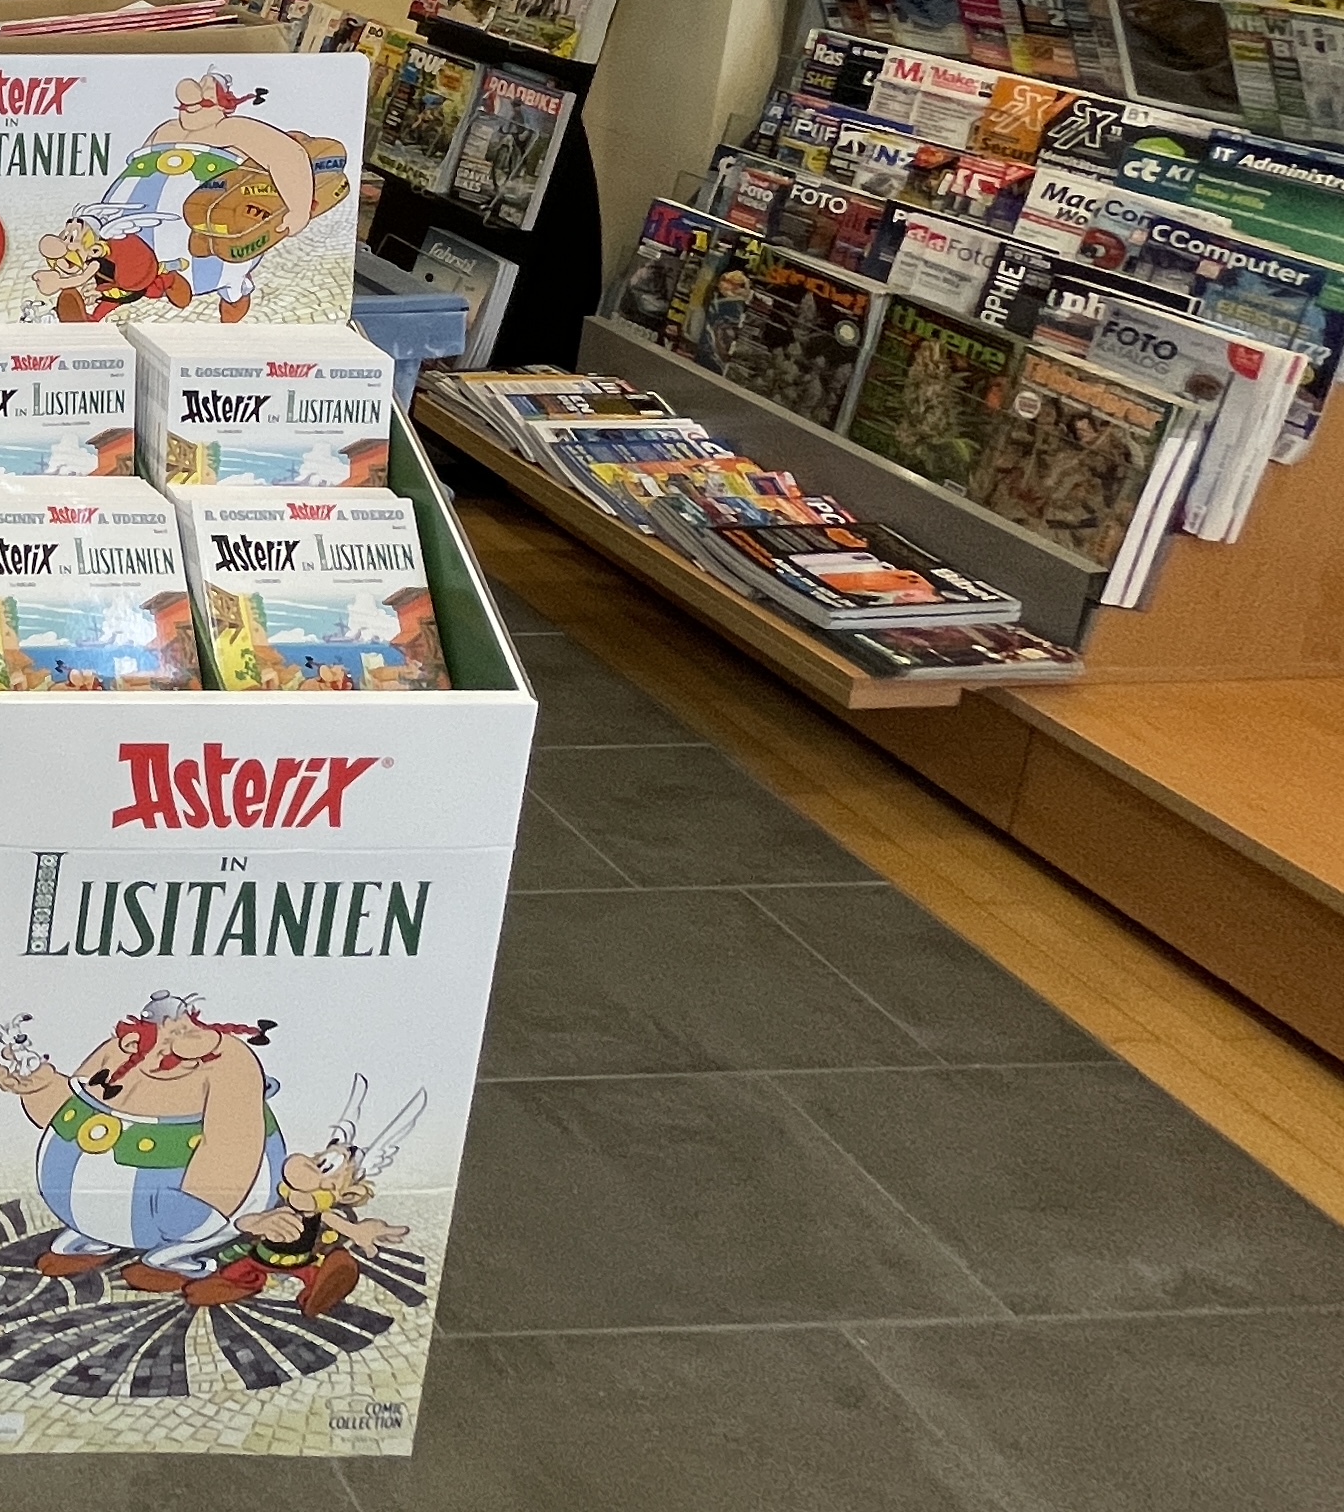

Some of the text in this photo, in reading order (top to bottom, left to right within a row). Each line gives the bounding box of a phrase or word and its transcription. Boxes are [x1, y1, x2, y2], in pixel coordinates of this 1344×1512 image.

[488, 76, 561, 115] ROADBIKE
[5, 118, 19, 127] IN
[1213, 145, 1236, 161] IT
[791, 183, 848, 215] FOTO
[1101, 320, 1179, 361] FOTO
[11, 353, 61, 372] Asterix
[72, 358, 125, 370] UDERZO
[194, 366, 263, 379] GOSCINNY
[266, 361, 319, 381] Asterix
[329, 367, 383, 380] UDERZO
[14, 406, 28, 417] IN
[31, 382, 126, 417] LUSITANIEN
[179, 388, 381, 426] Asterix IN LUSITANIEN
[48, 505, 100, 525] Asterix
[112, 512, 168, 526] UDERZO
[218, 509, 286, 523] GOSCINNY
[287, 502, 338, 521] Asterix
[350, 509, 405, 522] UDERZO
[58, 563, 73, 575] IN
[75, 537, 177, 576] LUSITANIEN
[210, 533, 417, 574] Asterix IN LUSITANIEN
[111, 742, 380, 830] Asterix
[220, 854, 248, 873] IN
[20, 851, 433, 958] LUSITANIEN
[364, 1402, 404, 1417] COMIC
[329, 1415, 404, 1431] COLLECTION
